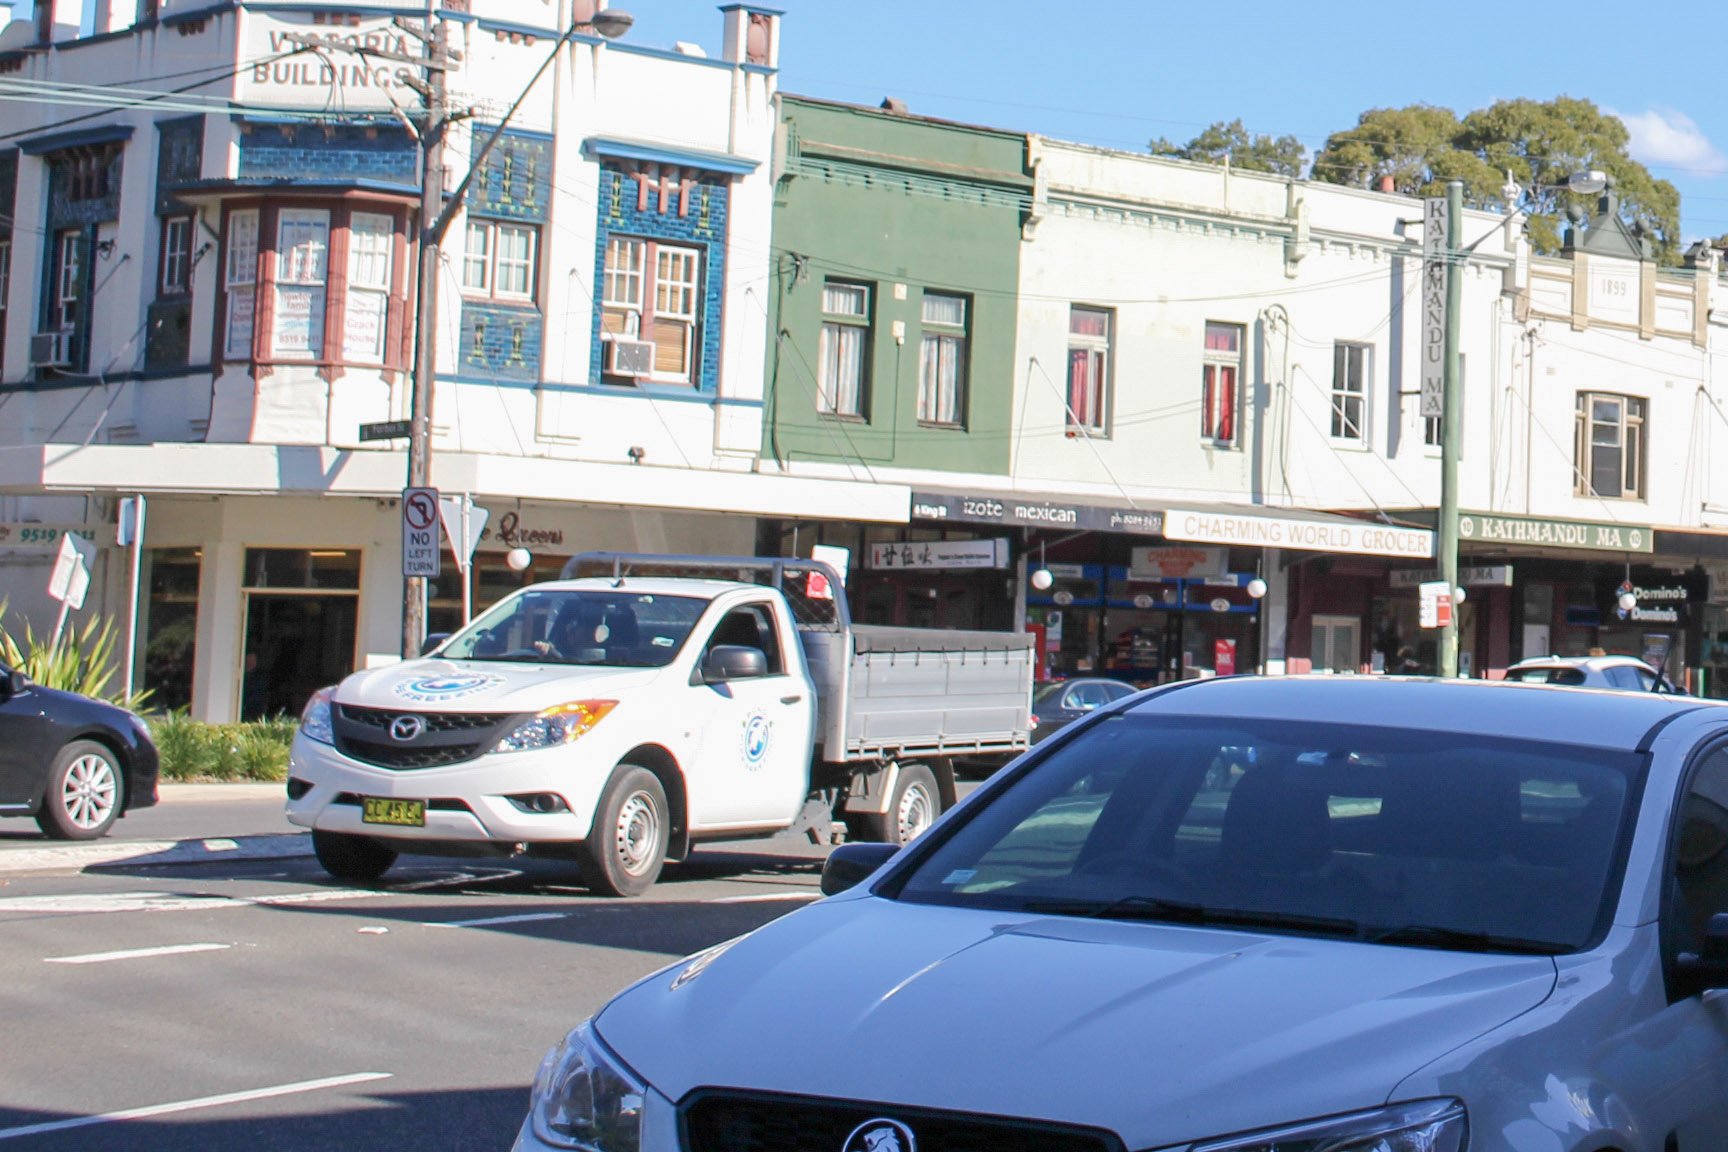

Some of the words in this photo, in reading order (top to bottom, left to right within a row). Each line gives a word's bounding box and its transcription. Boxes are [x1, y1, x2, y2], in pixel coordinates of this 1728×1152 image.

[253, 62, 411, 89] BUILDINGS
[1425, 377, 1443, 412] MA
[963, 496, 1003, 517] izote
[1015, 502, 1076, 523] mexican
[410, 533, 430, 546] NO
[1184, 516, 1281, 542] CHARMING
[1287, 526, 1351, 547] WORLD
[1361, 529, 1427, 553] GROCER
[1481, 517, 1588, 545] KATHMANDU
[1596, 529, 1622, 547] MA
[408, 549, 432, 559] LEFT
[407, 561, 433, 571] TURN
[1633, 586, 1687, 599] Domino's
[1631, 606, 1678, 622] Domino's
